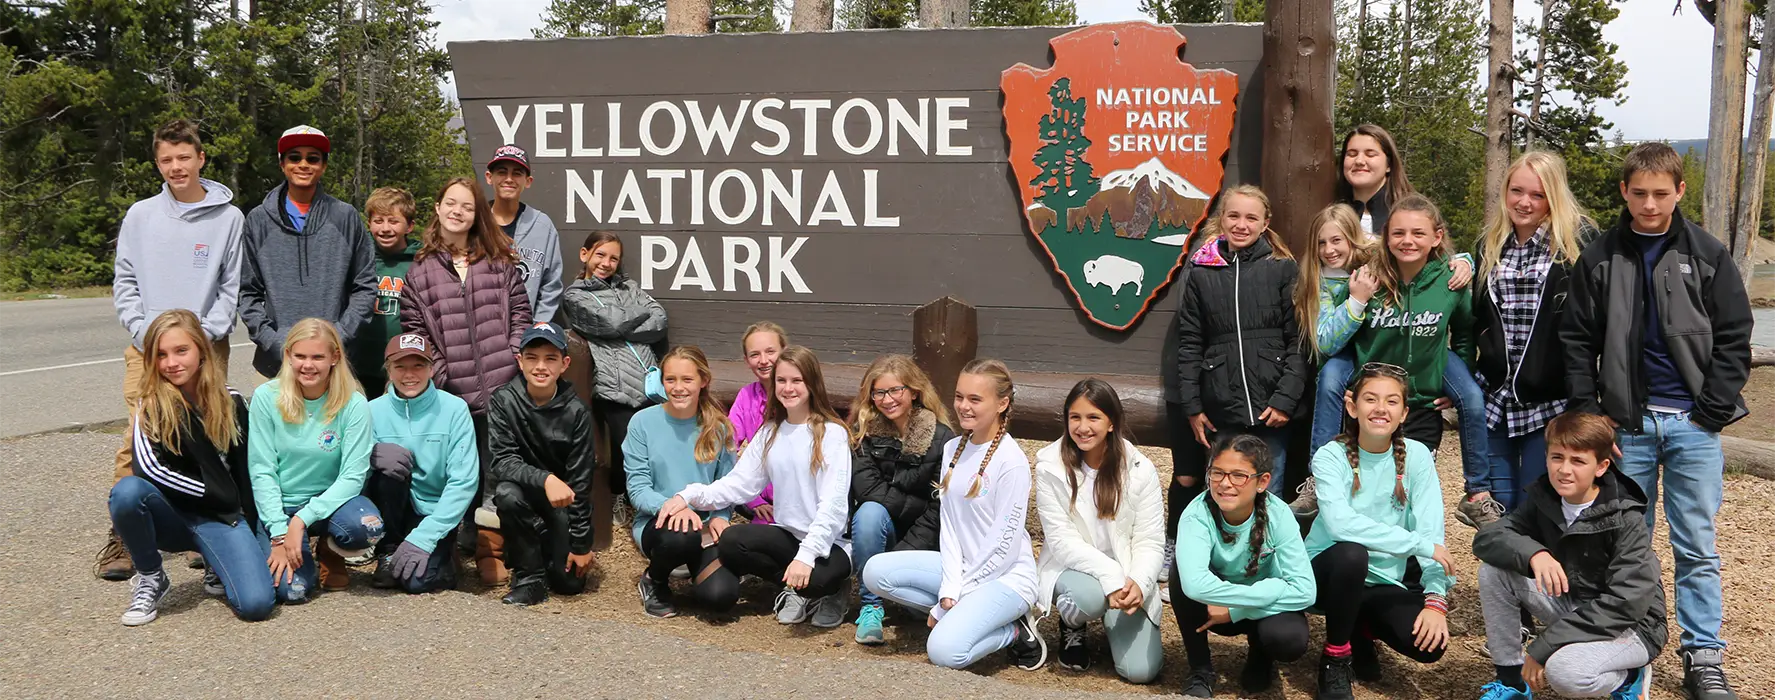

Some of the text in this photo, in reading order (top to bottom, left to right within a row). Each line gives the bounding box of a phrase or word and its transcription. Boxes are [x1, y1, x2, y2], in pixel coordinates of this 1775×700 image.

[1096, 87, 1221, 105] NATIONAL
[487, 98, 973, 157] YELLOWSTONE
[1126, 110, 1190, 129] PARK
[1108, 134, 1207, 152] SERVICE
[565, 168, 900, 226] NATIONAL
[640, 235, 813, 293] PARK
[1411, 326, 1438, 336] 1922
[994, 502, 1023, 560] JACKSON
